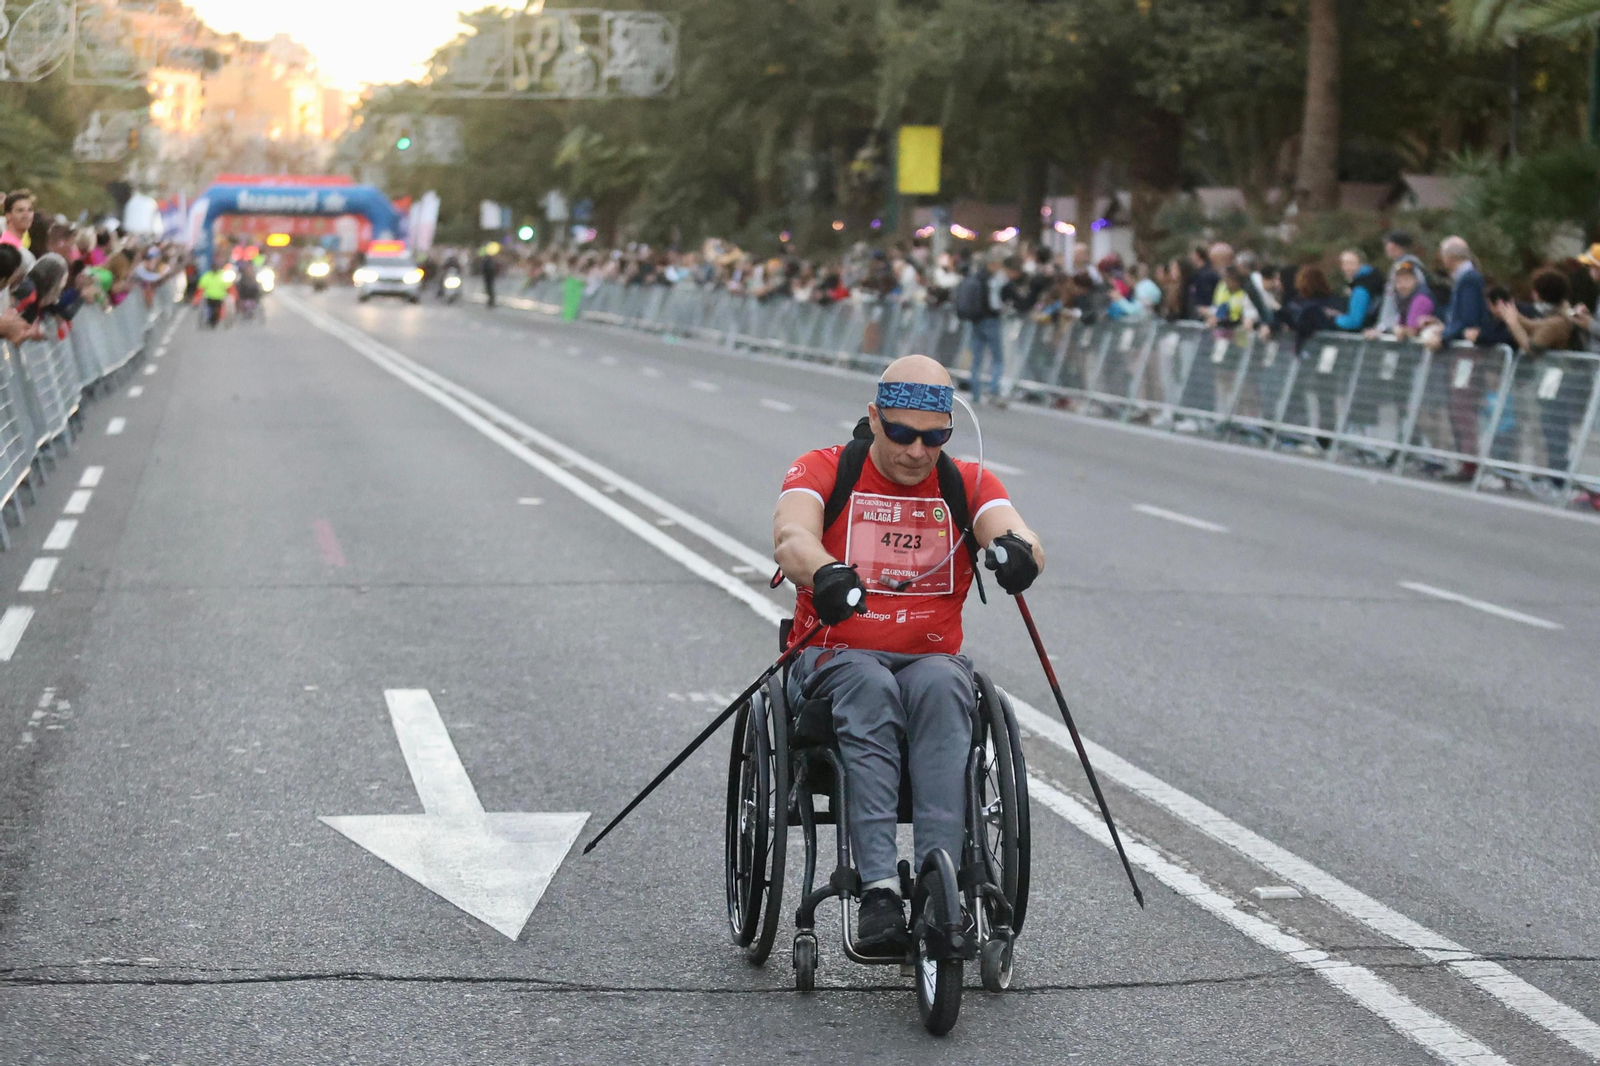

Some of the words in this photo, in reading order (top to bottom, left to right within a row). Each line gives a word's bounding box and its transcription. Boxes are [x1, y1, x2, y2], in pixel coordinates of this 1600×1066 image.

[864, 499, 892, 507] GENERALI
[863, 510, 891, 522] MÁLAGA
[881, 532, 922, 549] 4723
[889, 568, 919, 577] GENERALI
